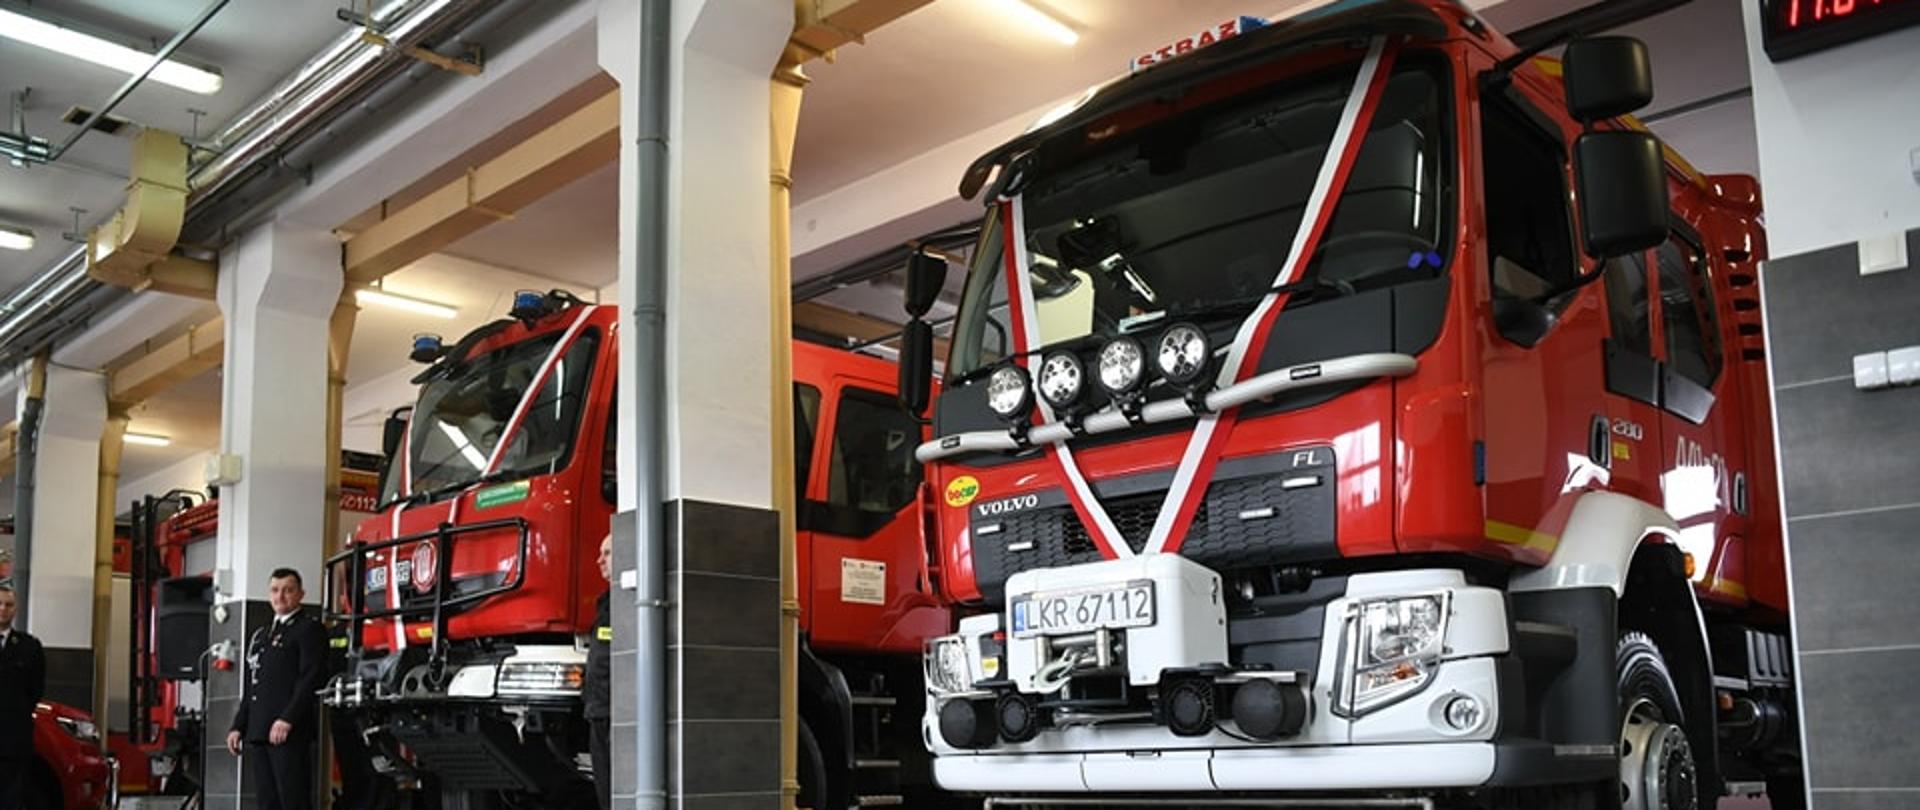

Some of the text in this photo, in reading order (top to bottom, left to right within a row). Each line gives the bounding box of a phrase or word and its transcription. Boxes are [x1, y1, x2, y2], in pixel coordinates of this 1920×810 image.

[1293, 450, 1322, 467] FL
[979, 494, 1038, 516] VOLVO
[1026, 588, 1149, 630] LKR 67112
